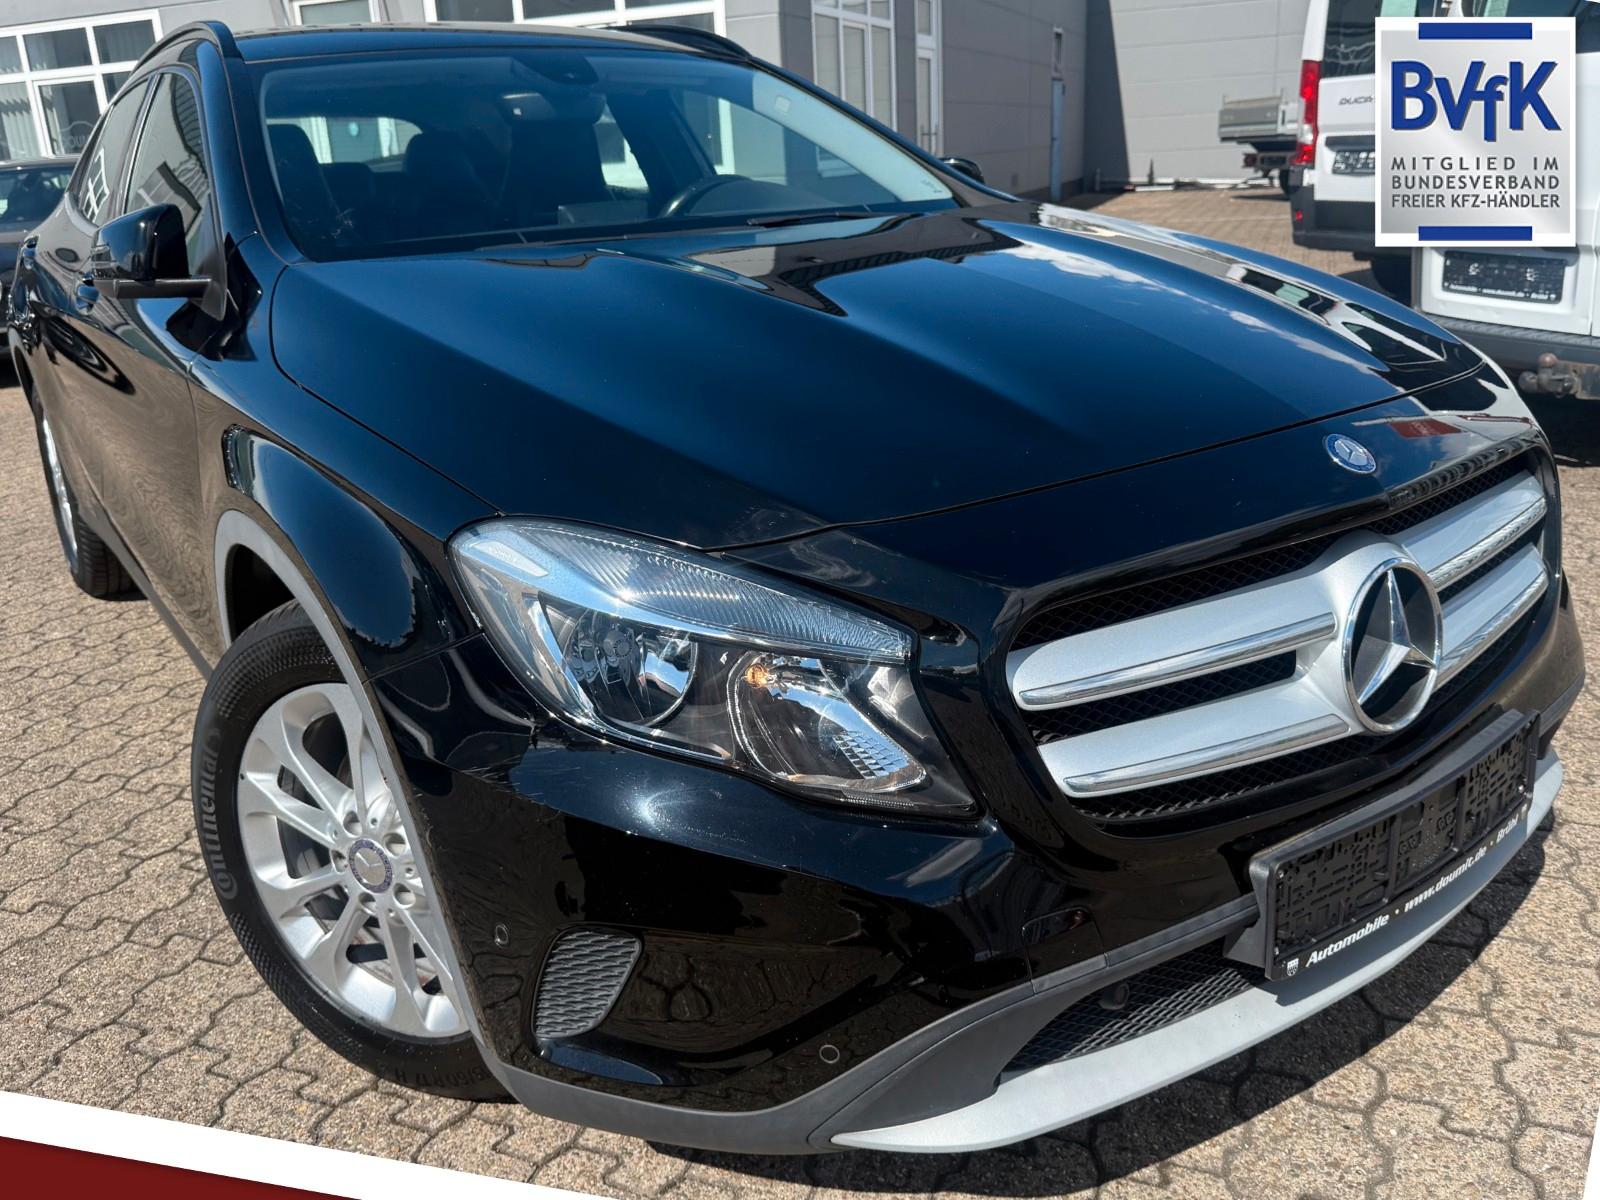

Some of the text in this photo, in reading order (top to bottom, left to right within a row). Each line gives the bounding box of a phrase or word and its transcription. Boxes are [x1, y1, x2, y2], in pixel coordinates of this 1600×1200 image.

[201, 744, 238, 900] Continental
[1305, 914, 1390, 968] Automobile
[1404, 846, 1487, 913] www.doumit.de
